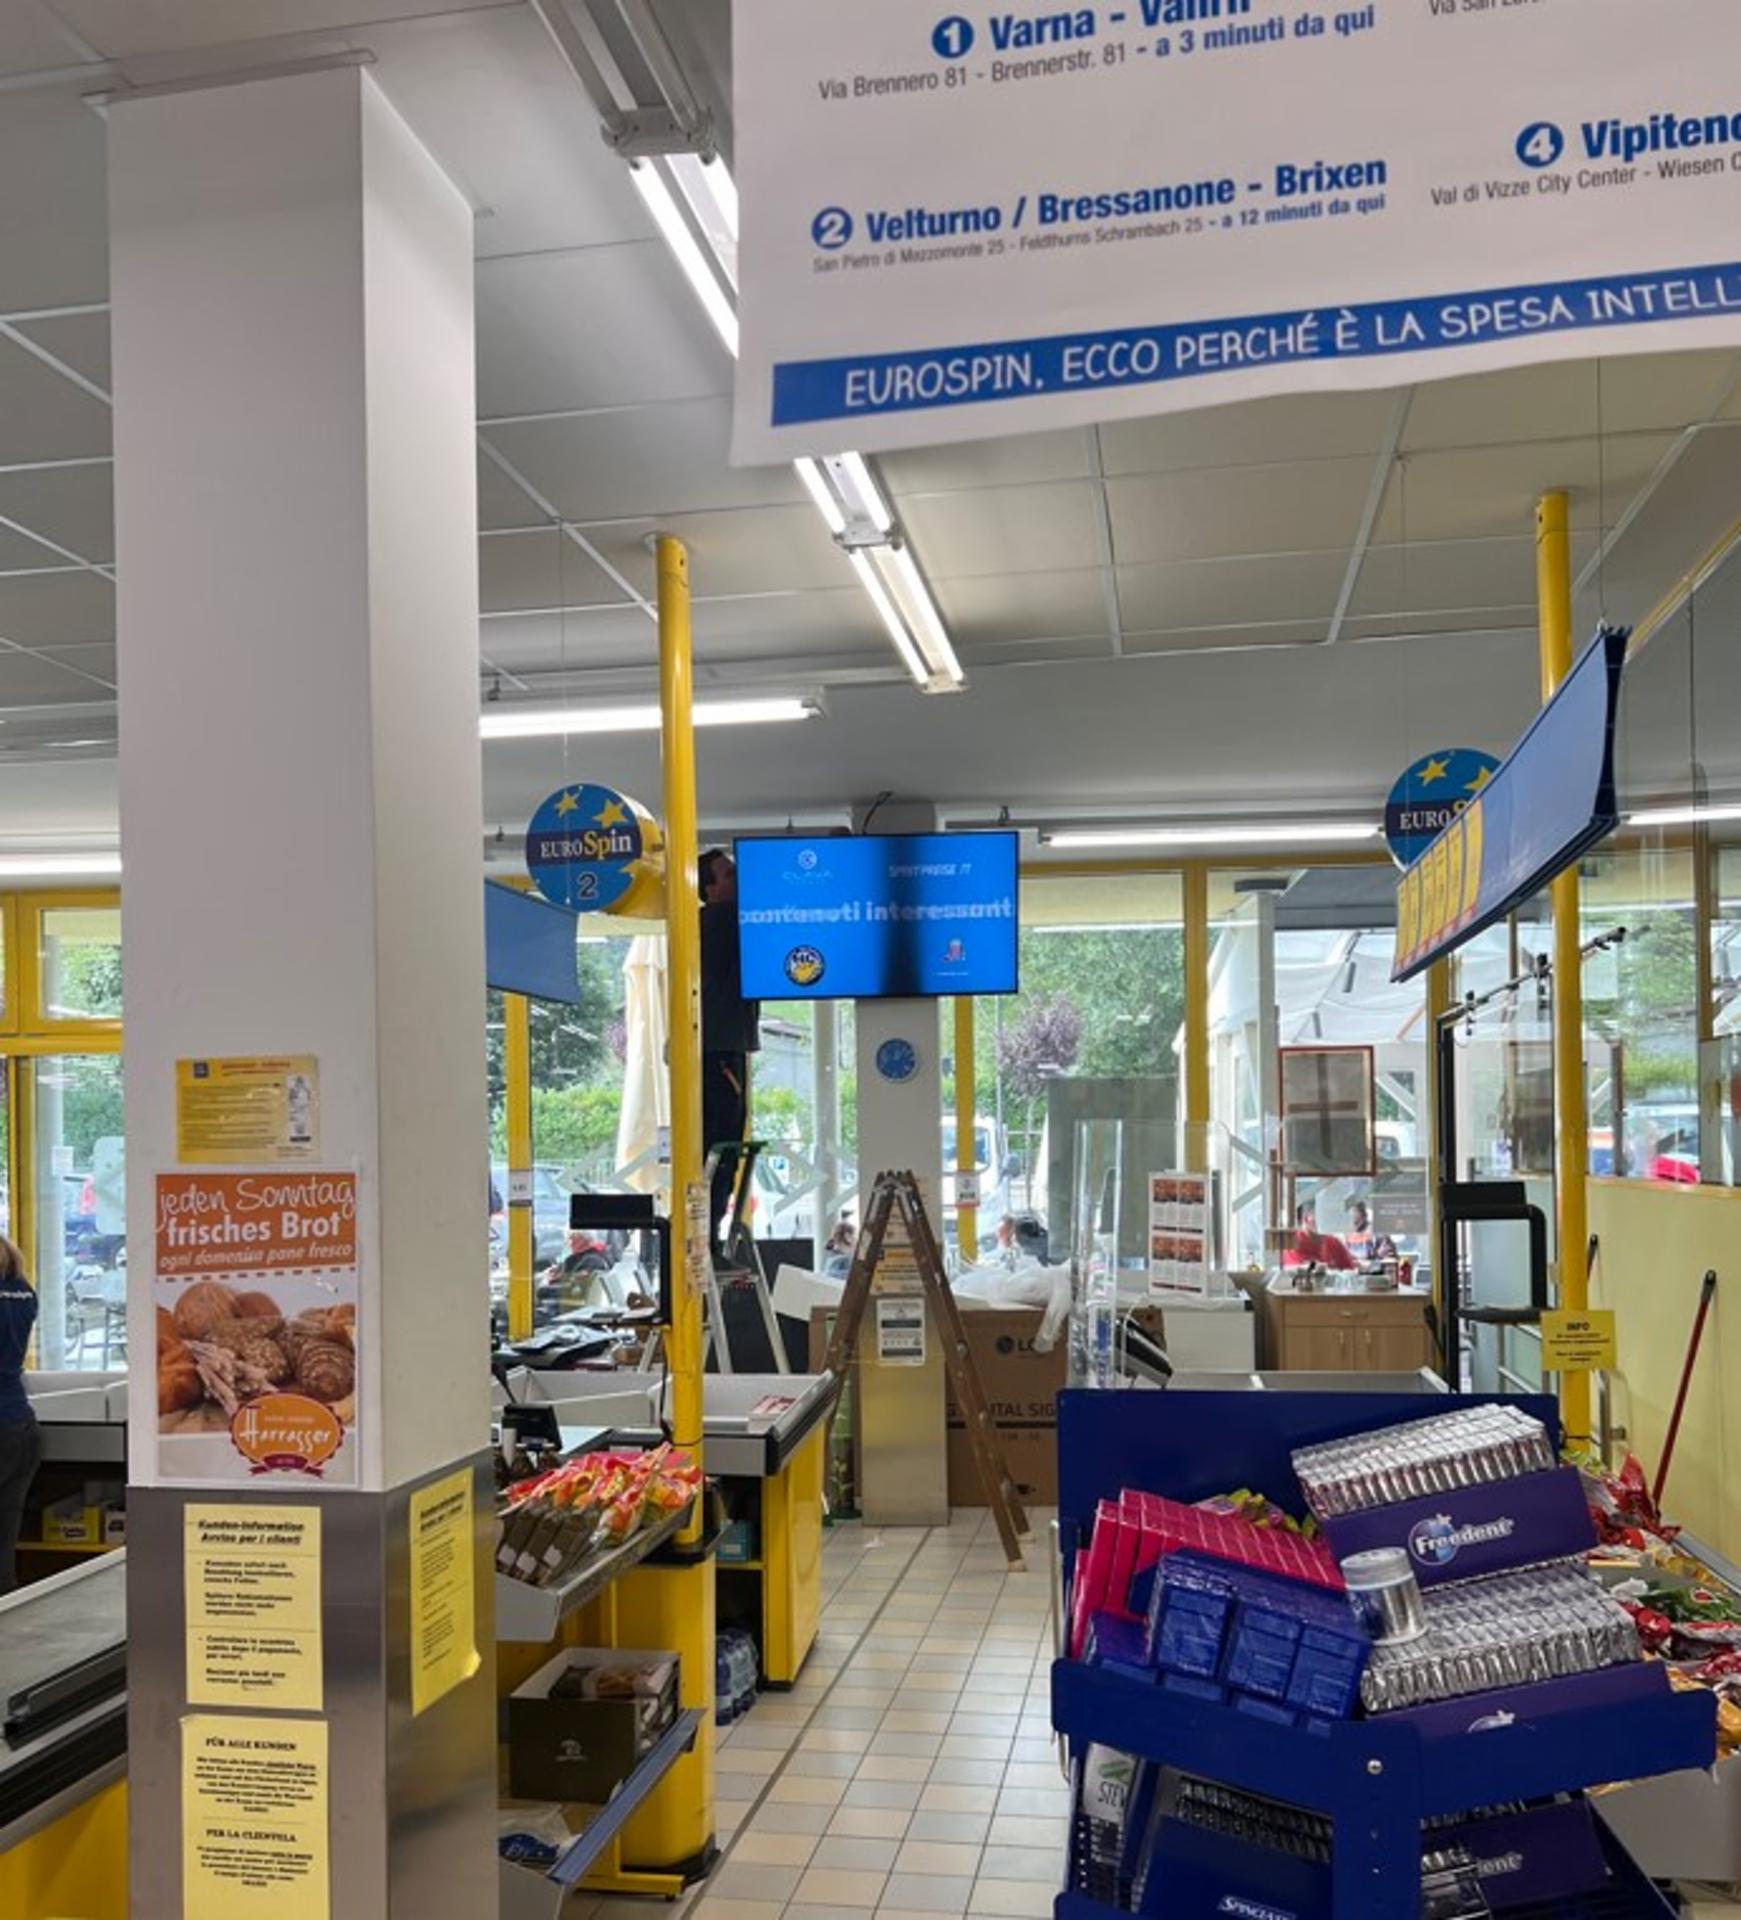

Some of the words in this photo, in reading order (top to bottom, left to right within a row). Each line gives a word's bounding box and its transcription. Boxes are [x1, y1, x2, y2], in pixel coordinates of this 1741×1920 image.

[989, 9, 1095, 51] Varna
[1428, 0, 1457, 15] Via
[818, 80, 847, 100] Via
[853, 72, 939, 97] Brennero
[944, 66, 967, 89] 81
[991, 49, 1096, 82] Brennerstr.
[1103, 42, 1126, 65] 81
[1155, 37, 1170, 57] a
[1179, 29, 1195, 53] 3
[1203, 17, 1285, 50] minuti
[1294, 13, 1325, 37] da
[1334, 4, 1375, 36] qui
[865, 206, 1001, 243] Velturno
[1038, 177, 1236, 226] Bressanone
[1275, 159, 1387, 197] Brixen
[1430, 186, 1458, 206] Val
[1463, 184, 1480, 202] di
[1485, 177, 1530, 199] Vizze
[1537, 172, 1572, 195] City
[1577, 166, 1637, 189] Center
[1657, 158, 1725, 180] Wiesen
[813, 256, 839, 273] San
[842, 252, 881, 270] Pietro
[884, 249, 895, 266] di
[987, 239, 1005, 255] 25
[1095, 217, 1180, 244] Schrambach
[1185, 217, 1202, 233] 25
[1222, 213, 1232, 229] a
[1240, 208, 1260, 226] 12
[1265, 199, 1322, 222] minuti
[1328, 196, 1350, 214] da
[1356, 192, 1386, 214] qui
[845, 352, 1044, 408] EUROSPIN,
[1061, 338, 1160, 383] ECCO
[1175, 311, 1320, 370] PERCHÉ
[1335, 308, 1360, 351] È
[1374, 310, 1425, 347] LA
[1439, 294, 1575, 340] SPESA
[1584, 275, 1741, 320] INTELL
[577, 871, 598, 898] 2
[155, 1183, 230, 1233] jeden
[236, 1175, 357, 1220] Sonntag
[167, 1213, 272, 1247] frisches
[281, 1210, 342, 1240] Brot
[267, 1247, 305, 1264] pane
